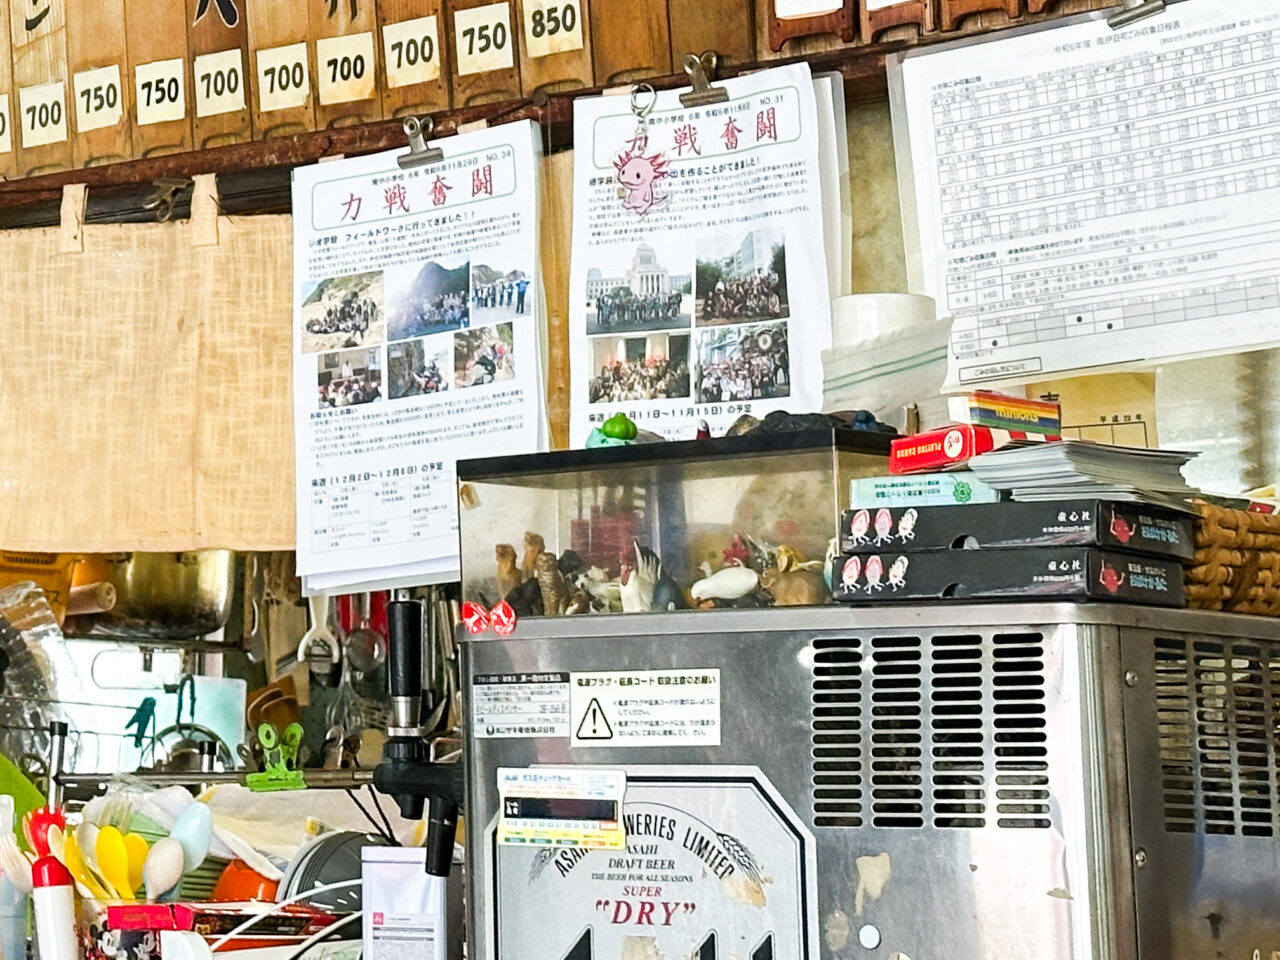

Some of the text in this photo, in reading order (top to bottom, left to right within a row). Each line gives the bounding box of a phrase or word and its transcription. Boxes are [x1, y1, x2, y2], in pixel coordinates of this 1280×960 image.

[531, 3, 577, 38] 850
[390, 34, 434, 70] 700
[462, 20, 507, 57] 750
[201, 66, 239, 98] 700
[264, 60, 304, 94] 700
[327, 53, 365, 83] 700
[80, 82, 117, 114] 750
[141, 76, 180, 107] 750
[26, 99, 62, 130] 700
[340, 164, 494, 222] 力戦奮闘
[994, 407, 1040, 424] minions
[608, 858, 675, 871] DRAFT BEER
[625, 844, 658, 855] ASAHI
[622, 885, 662, 897] SUPER
